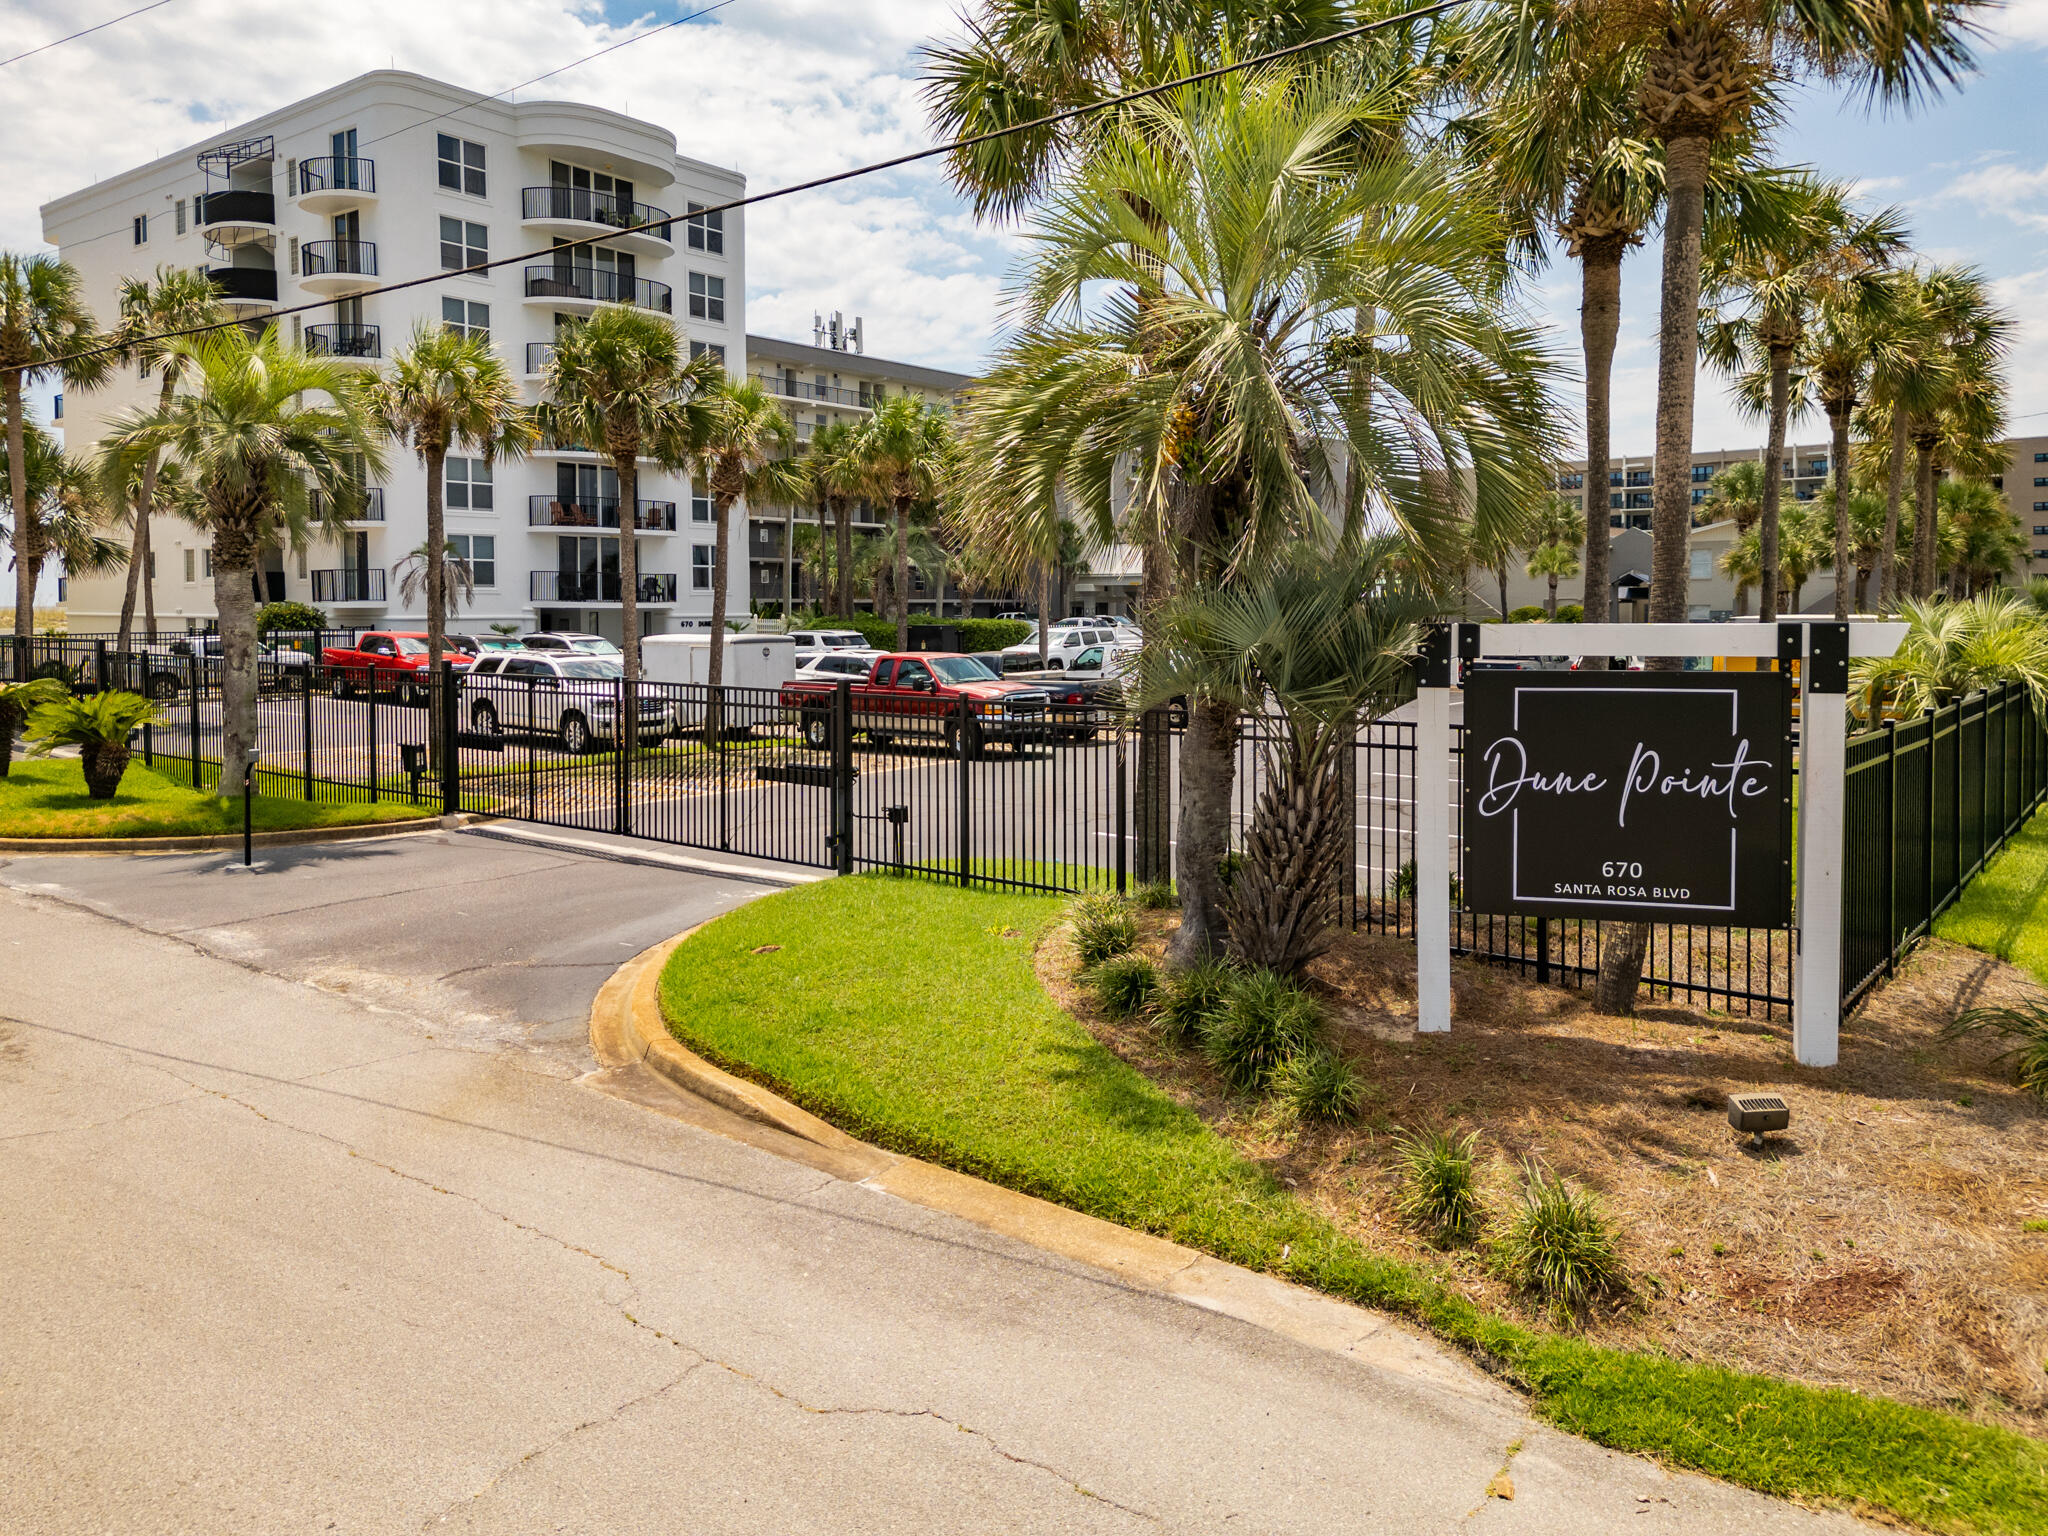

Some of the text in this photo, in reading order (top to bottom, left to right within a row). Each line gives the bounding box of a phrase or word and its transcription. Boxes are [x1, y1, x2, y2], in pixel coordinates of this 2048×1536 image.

[1479, 737, 1772, 828] Dune Pointe
[1602, 861, 1643, 878] 670
[1554, 883, 1690, 899] SANTA ROSA BLVD
